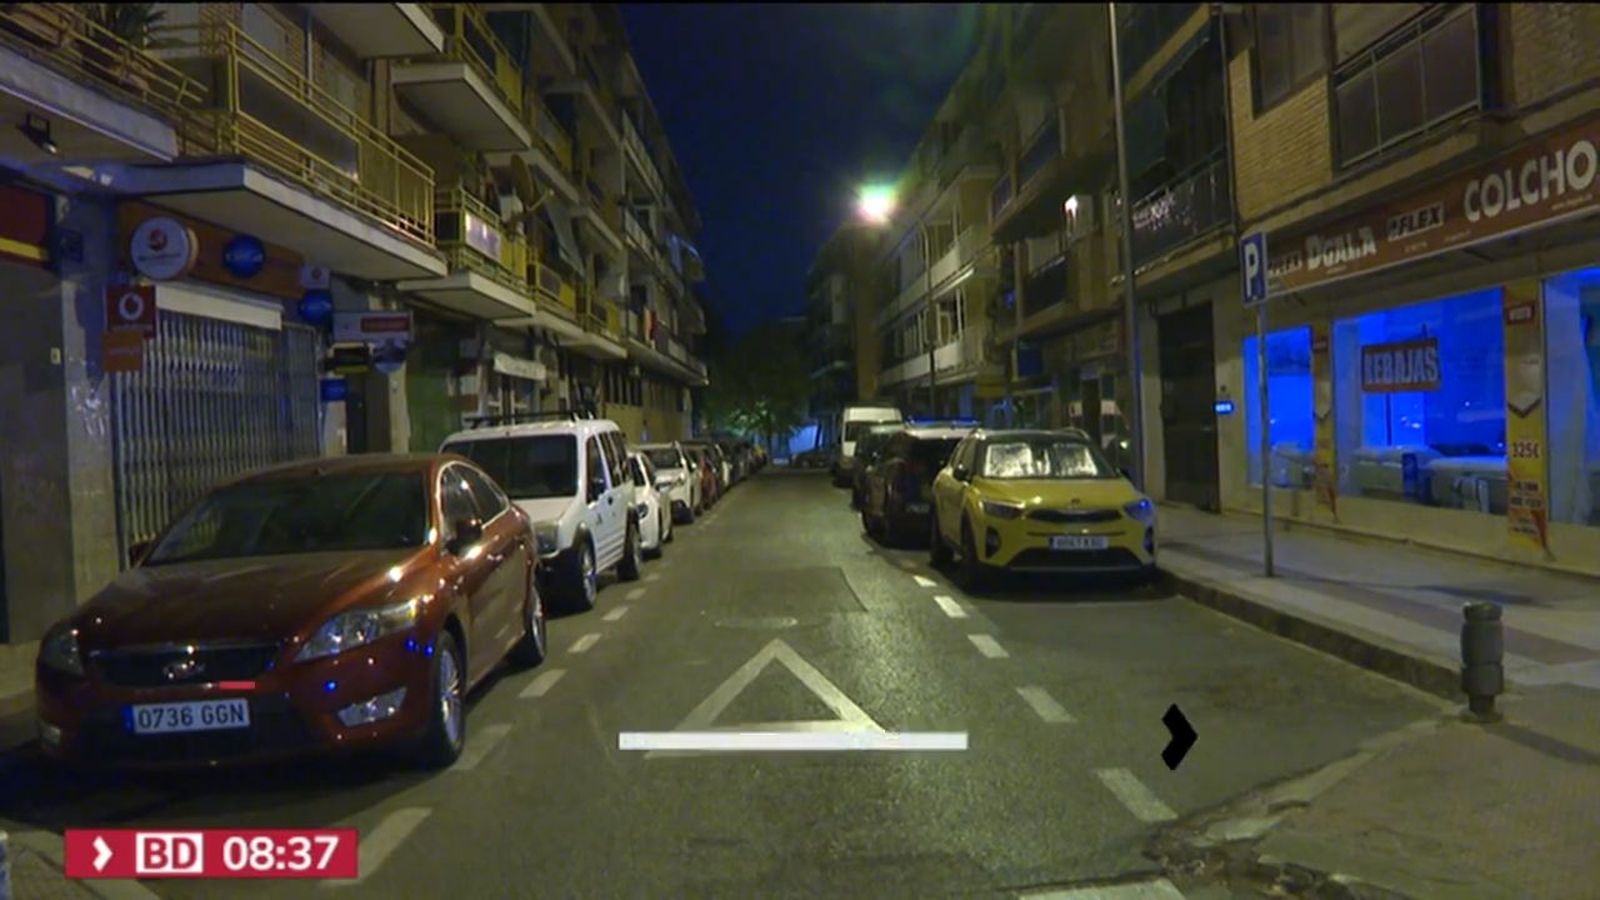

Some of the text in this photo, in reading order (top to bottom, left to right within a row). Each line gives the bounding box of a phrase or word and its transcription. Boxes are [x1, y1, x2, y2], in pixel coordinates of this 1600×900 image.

[1464, 140, 1598, 223] COLCHO
[1244, 242, 1259, 298] P
[1366, 347, 1438, 385] REBAJAS
[137, 703, 245, 729] 0736 GGN
